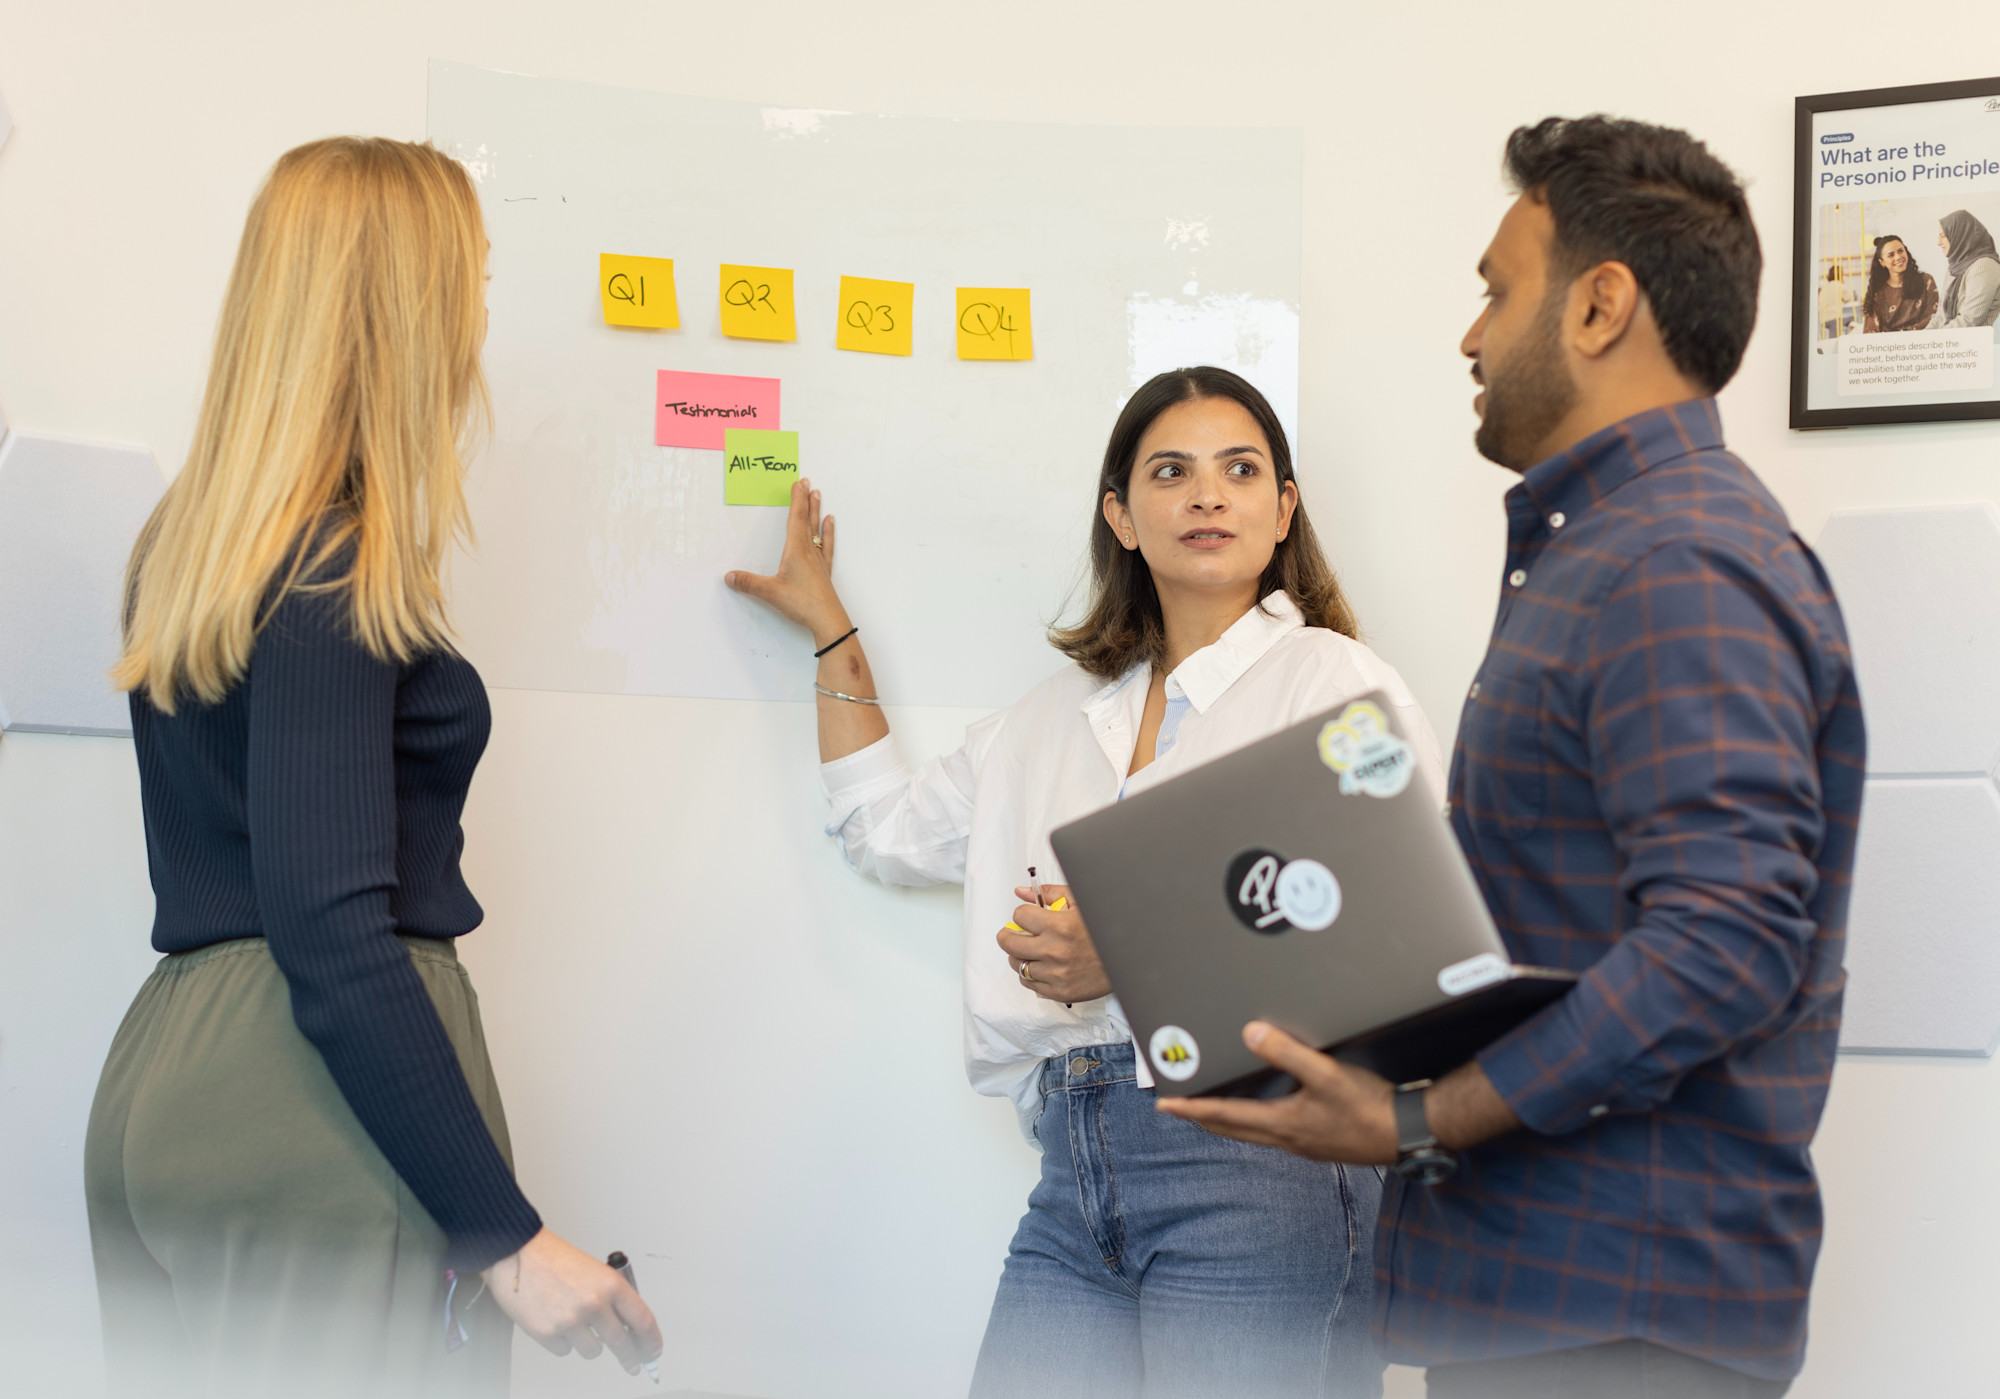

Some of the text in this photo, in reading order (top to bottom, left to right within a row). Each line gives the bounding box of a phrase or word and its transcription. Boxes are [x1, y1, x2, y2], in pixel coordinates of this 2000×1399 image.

[1823, 134, 1852, 144] Principles
[1821, 141, 1946, 165] What are the
[1820, 159, 2000, 188] Personio Principle
[608, 273, 644, 307] Q1
[725, 279, 777, 314] Q2
[846, 300, 895, 336] Q3
[959, 301, 1019, 358] Q4
[1849, 340, 1960, 354] Our Principles describe the
[1848, 349, 1979, 364] mindset, behaviors, and specific
[1848, 361, 1977, 376] capabilities that guide the ways
[1862, 376, 1883, 384] work
[1884, 374, 1921, 385] together.
[665, 402, 758, 418] Testimonials
[729, 455, 797, 473] All-Team
